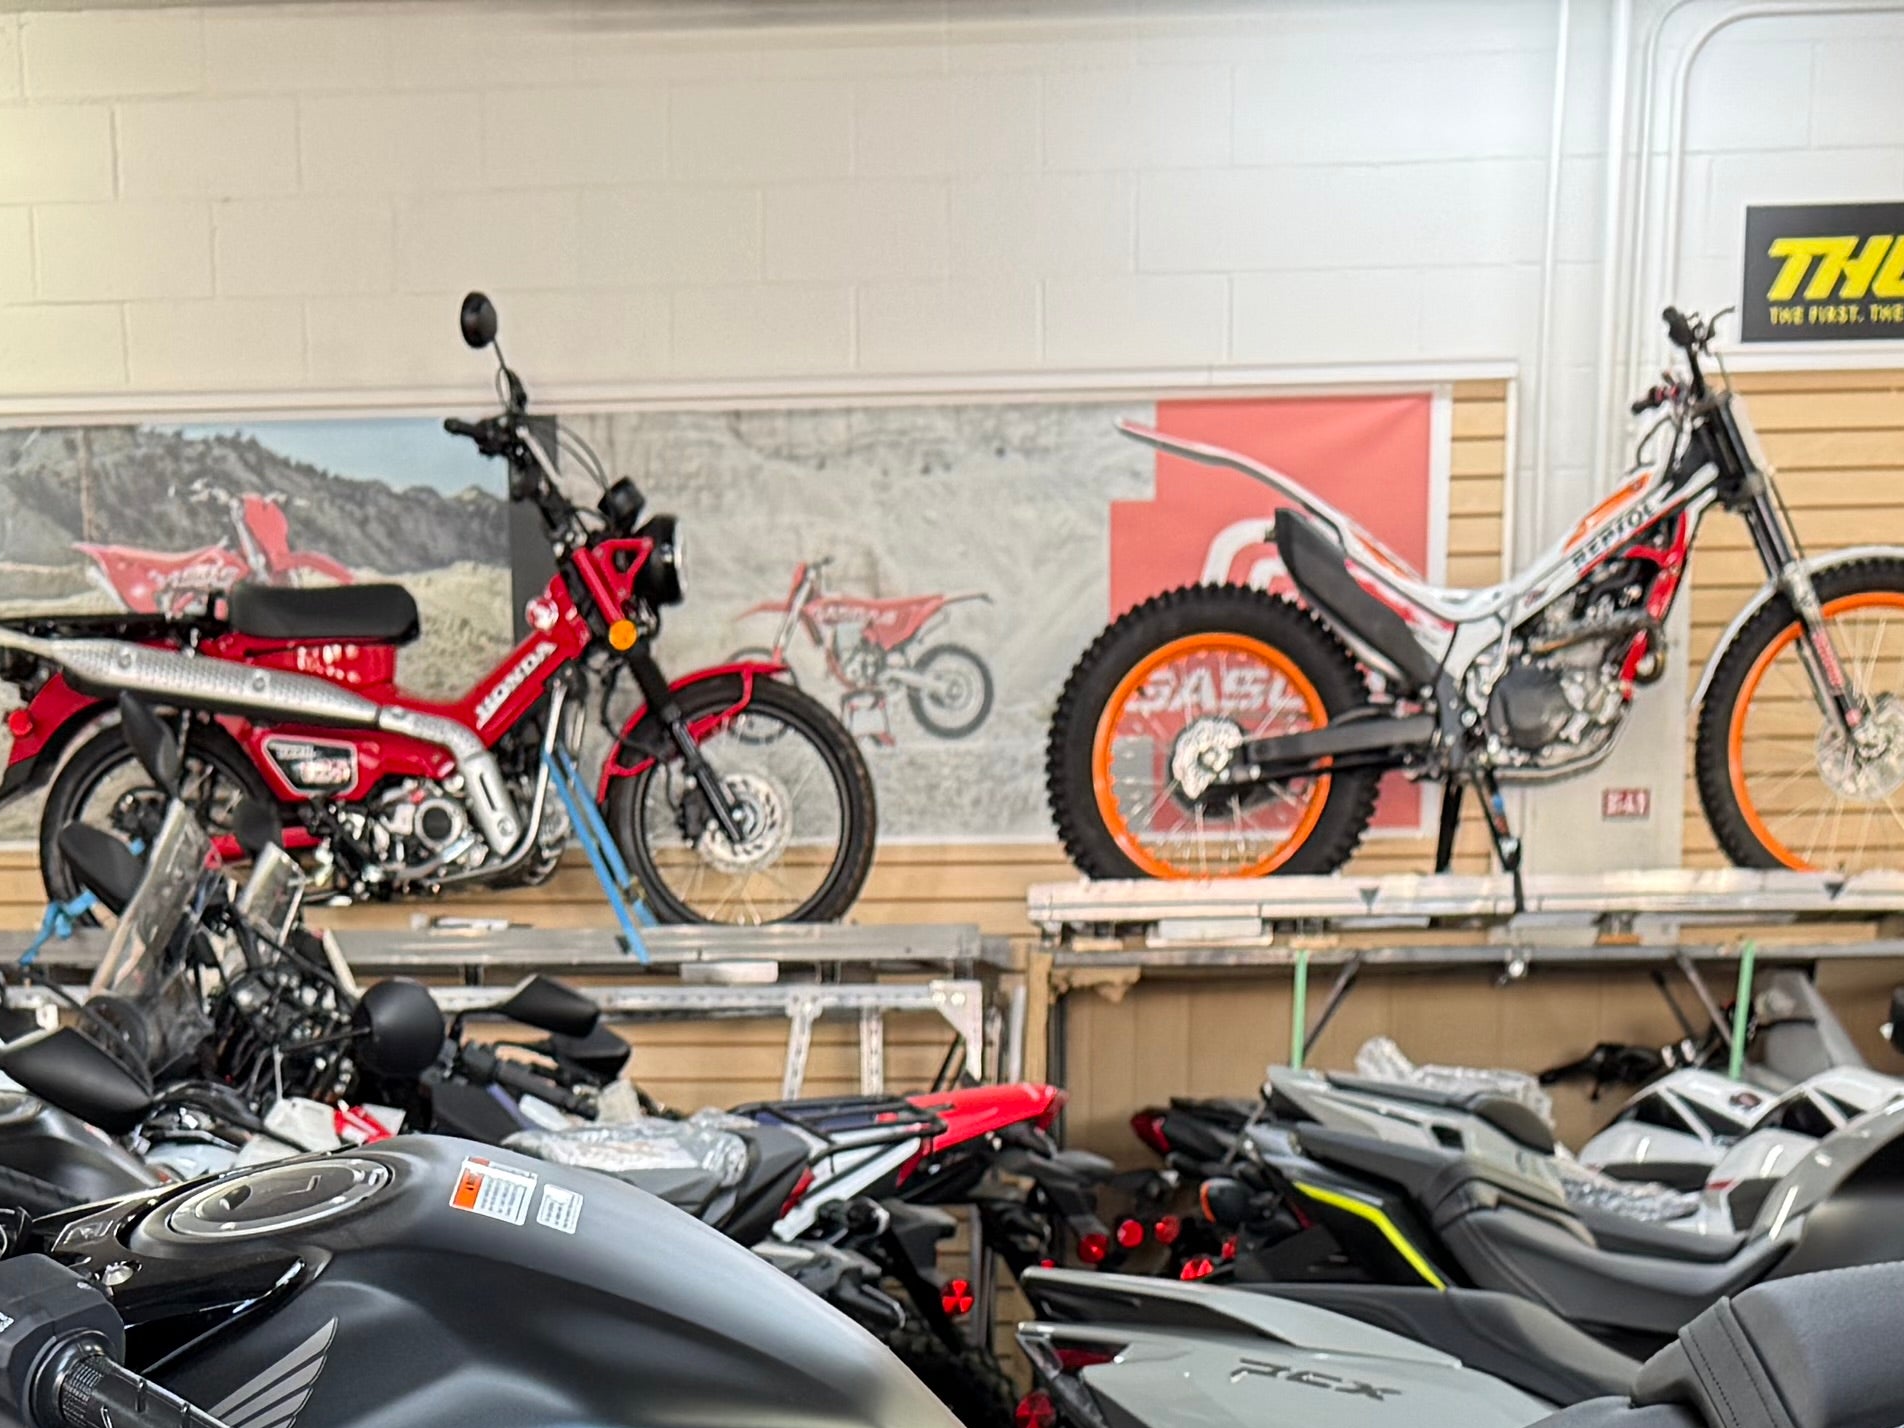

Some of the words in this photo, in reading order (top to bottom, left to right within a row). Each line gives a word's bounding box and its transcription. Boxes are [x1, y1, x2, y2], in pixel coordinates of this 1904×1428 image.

[1770, 306, 1803, 325] THE
[1809, 305, 1864, 324] FIRST.
[1870, 304, 1904, 323] THE
[474, 640, 558, 731] HONDA
[1230, 1357, 1402, 1402] PCX
